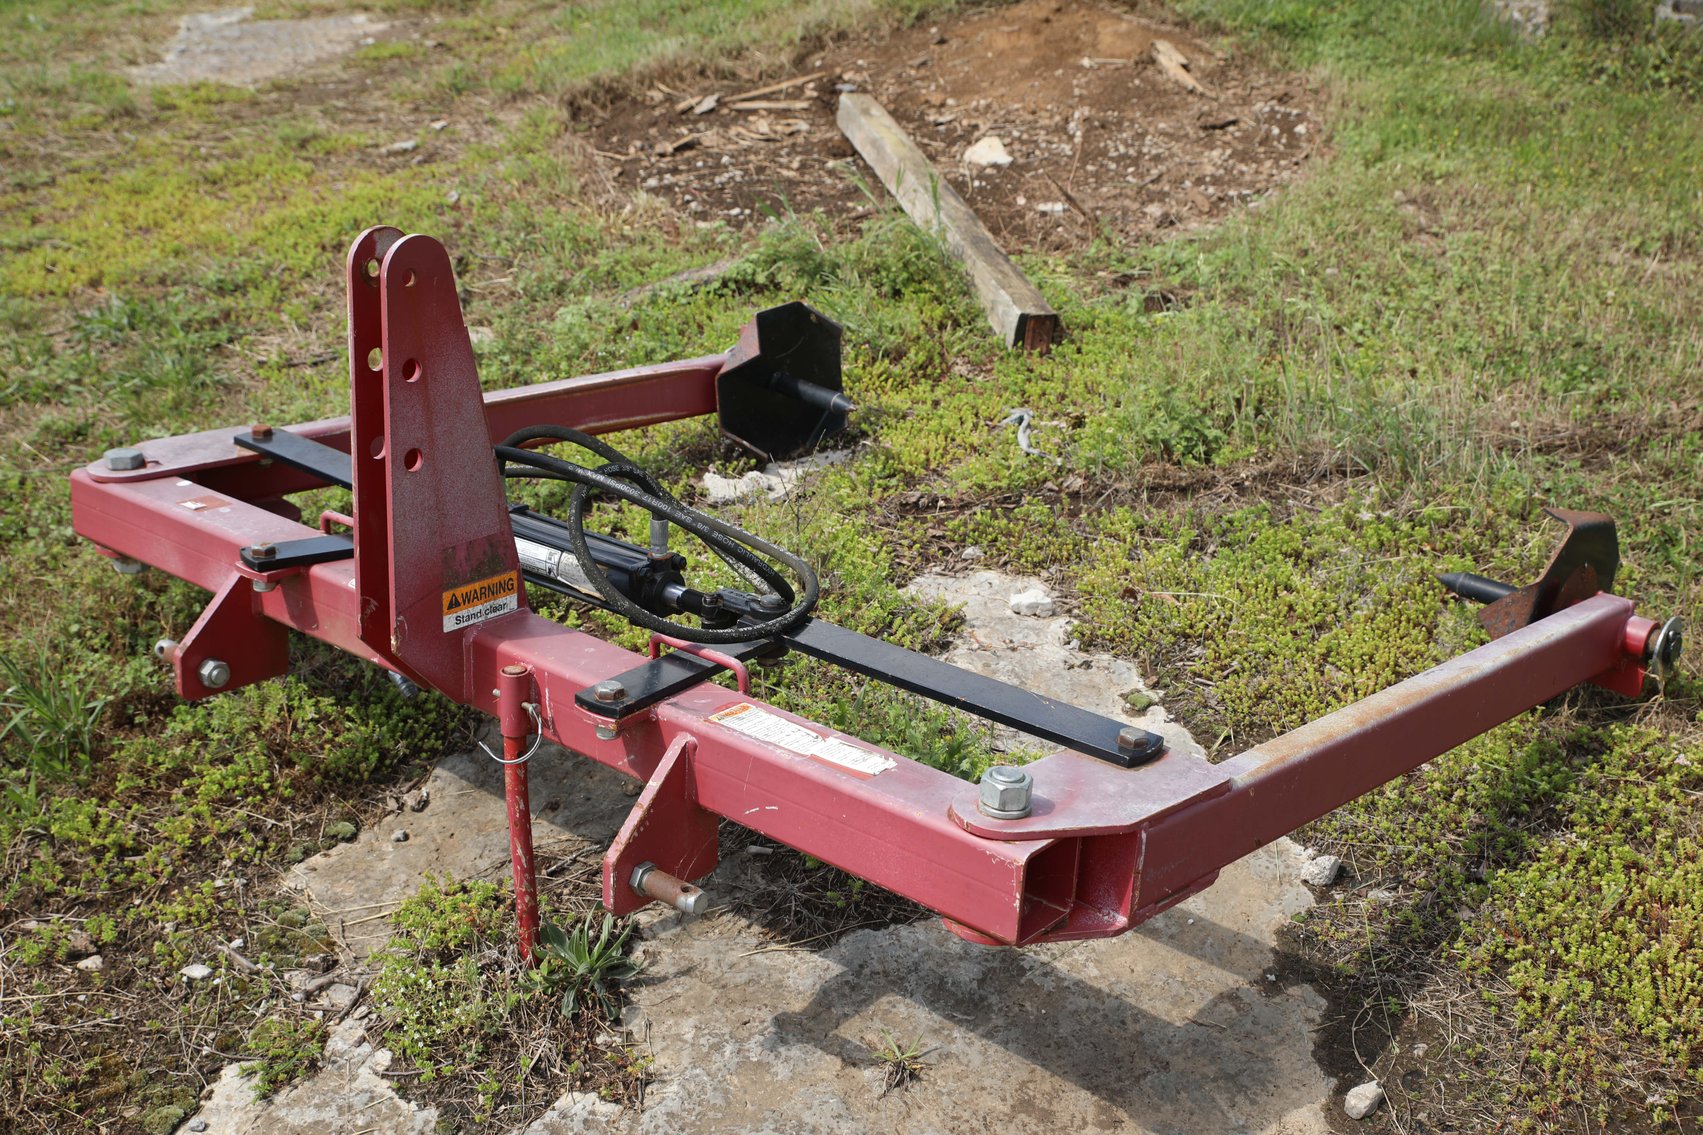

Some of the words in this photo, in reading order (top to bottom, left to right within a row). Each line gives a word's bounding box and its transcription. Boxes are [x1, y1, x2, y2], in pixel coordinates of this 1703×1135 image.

[586, 470, 605, 482] MAX
[641, 494, 672, 512] 100R17
[674, 510, 693, 523] SAE
[711, 530, 735, 548] HOSE
[737, 546, 775, 577] HYDRAULIC
[461, 577, 515, 606] WARNING
[454, 609, 483, 626] Stand
[484, 602, 507, 616] clear
